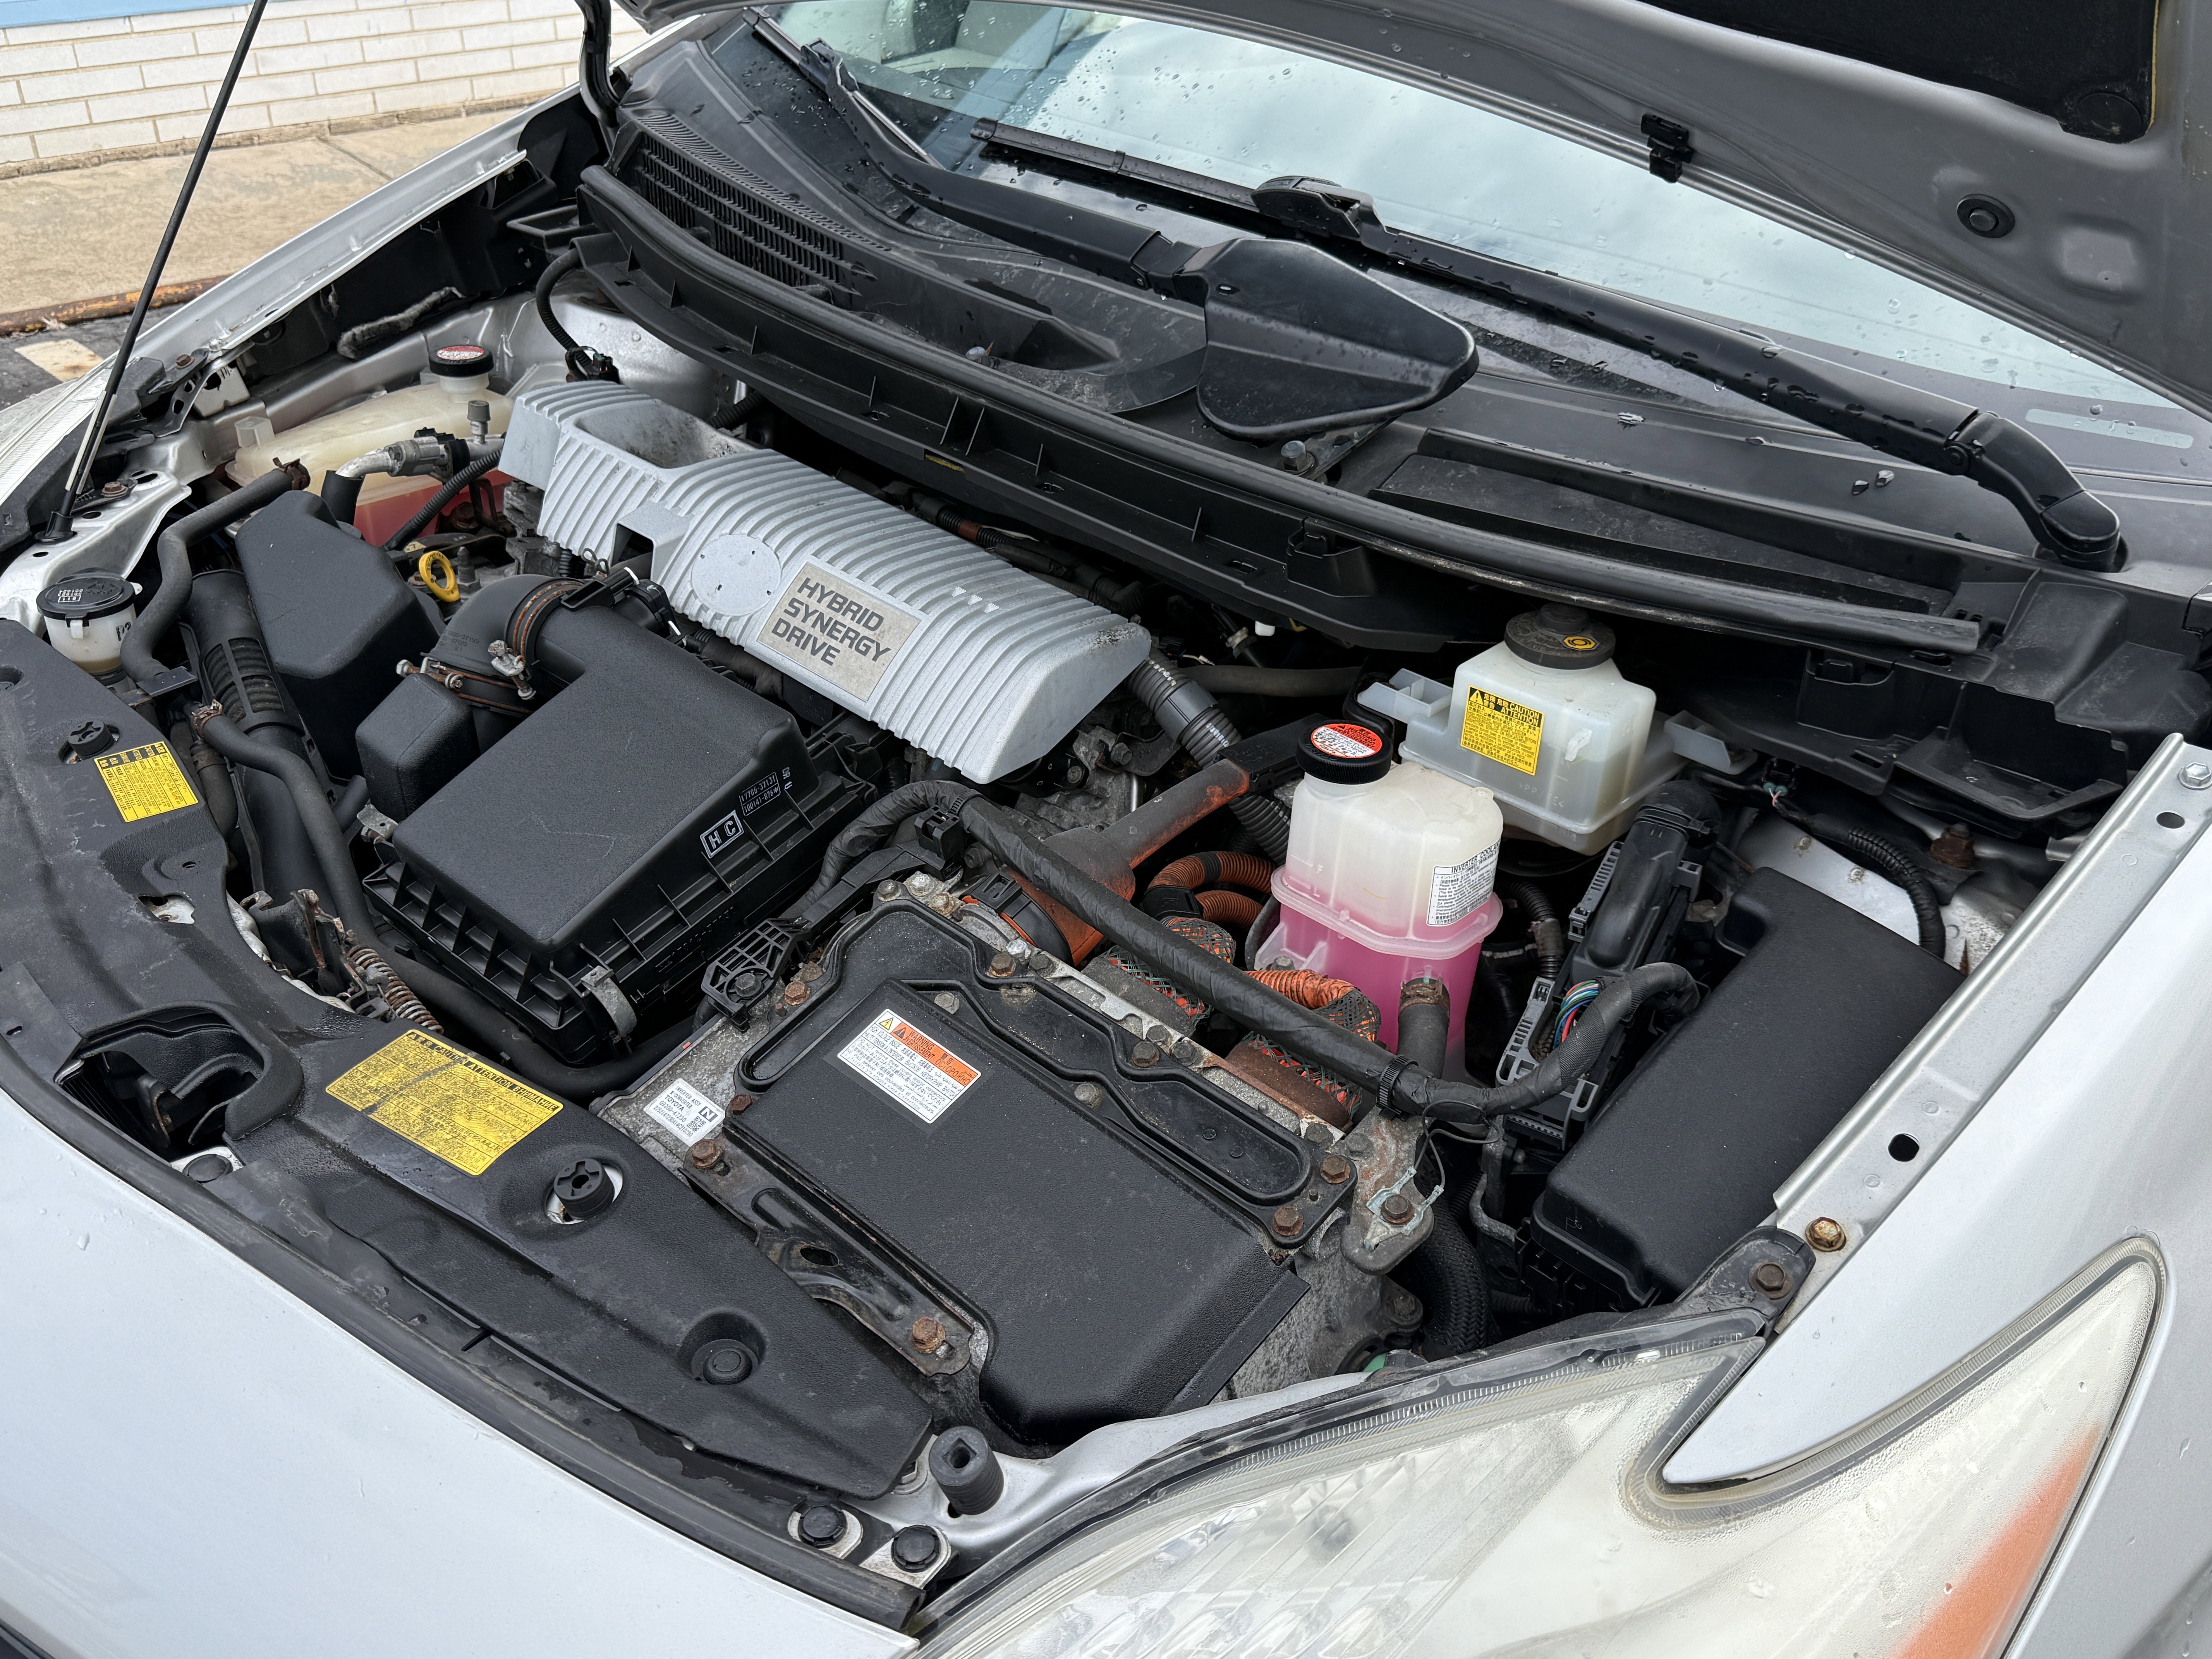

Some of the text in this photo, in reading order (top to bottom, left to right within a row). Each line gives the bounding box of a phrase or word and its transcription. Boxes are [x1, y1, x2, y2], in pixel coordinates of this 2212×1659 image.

[797, 577, 884, 631] HYBRID
[784, 598, 892, 663] SYNERGY
[772, 620, 840, 666] DRIVE
[1501, 706, 1538, 726] ATTENTION
[1510, 703, 1539, 720] CAUTION
[1451, 855, 1477, 873] INVERTER
[908, 1030, 935, 1051] WARNING
[433, 1045, 558, 1111] CAUTION ATTENTION ВНИМАНИЕ
[664, 1094, 685, 1111] TOYOTA
[675, 1085, 692, 1099] INVERTER
[691, 1098, 702, 1106] ASSY
[658, 1100, 687, 1123] G9200-47230
